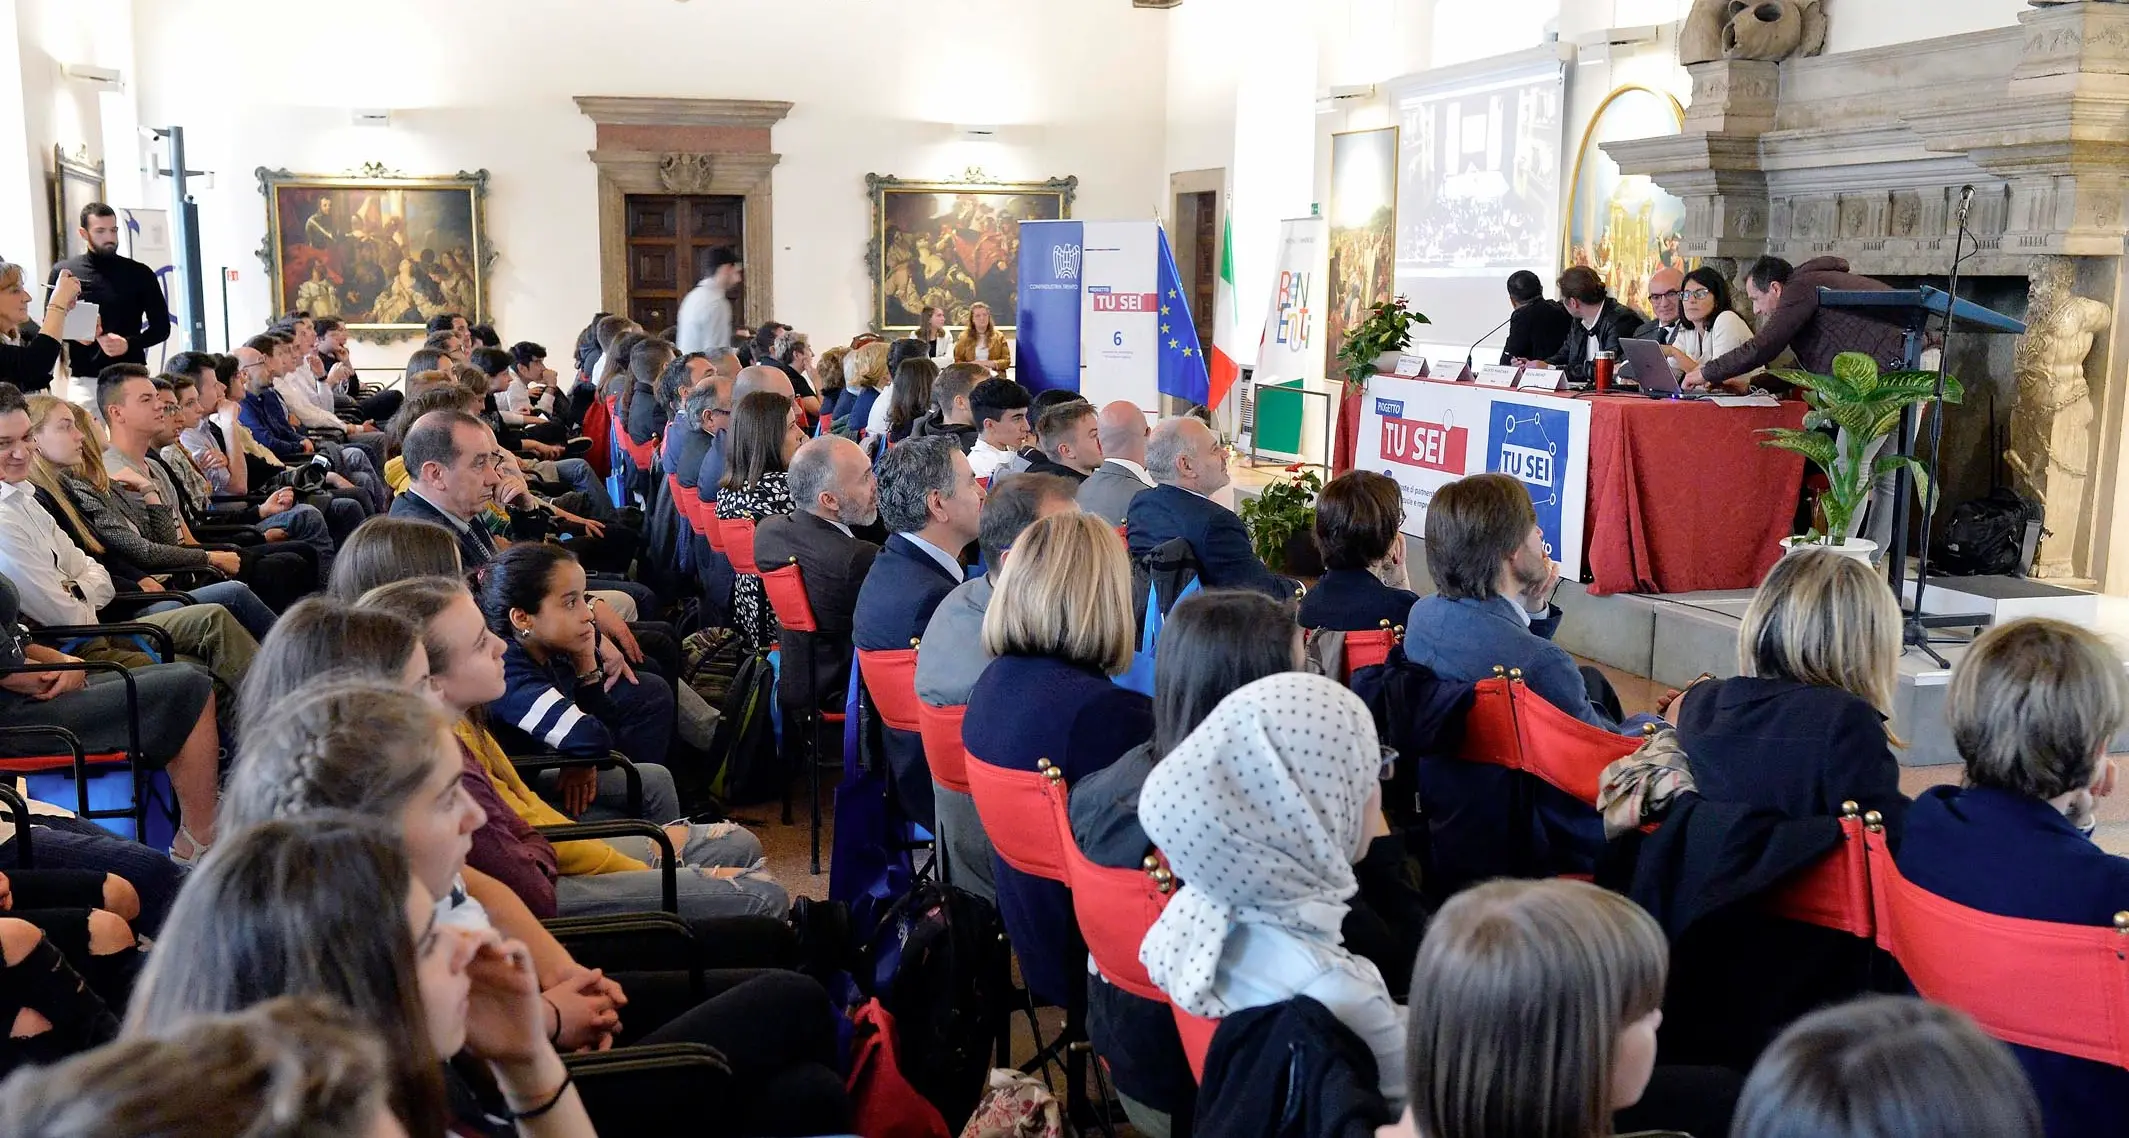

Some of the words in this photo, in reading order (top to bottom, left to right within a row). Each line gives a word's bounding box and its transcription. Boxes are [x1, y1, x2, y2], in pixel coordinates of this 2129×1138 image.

[1097, 295, 1116, 310] TU
[1120, 295, 1142, 310] SEI
[1113, 331, 1122, 346] 6
[1377, 401, 1401, 414] PROGETTO
[1385, 421, 1407, 457] TU
[1412, 426, 1447, 465] SEI
[1503, 450, 1522, 475] TU
[1526, 454, 1550, 482] SEI
